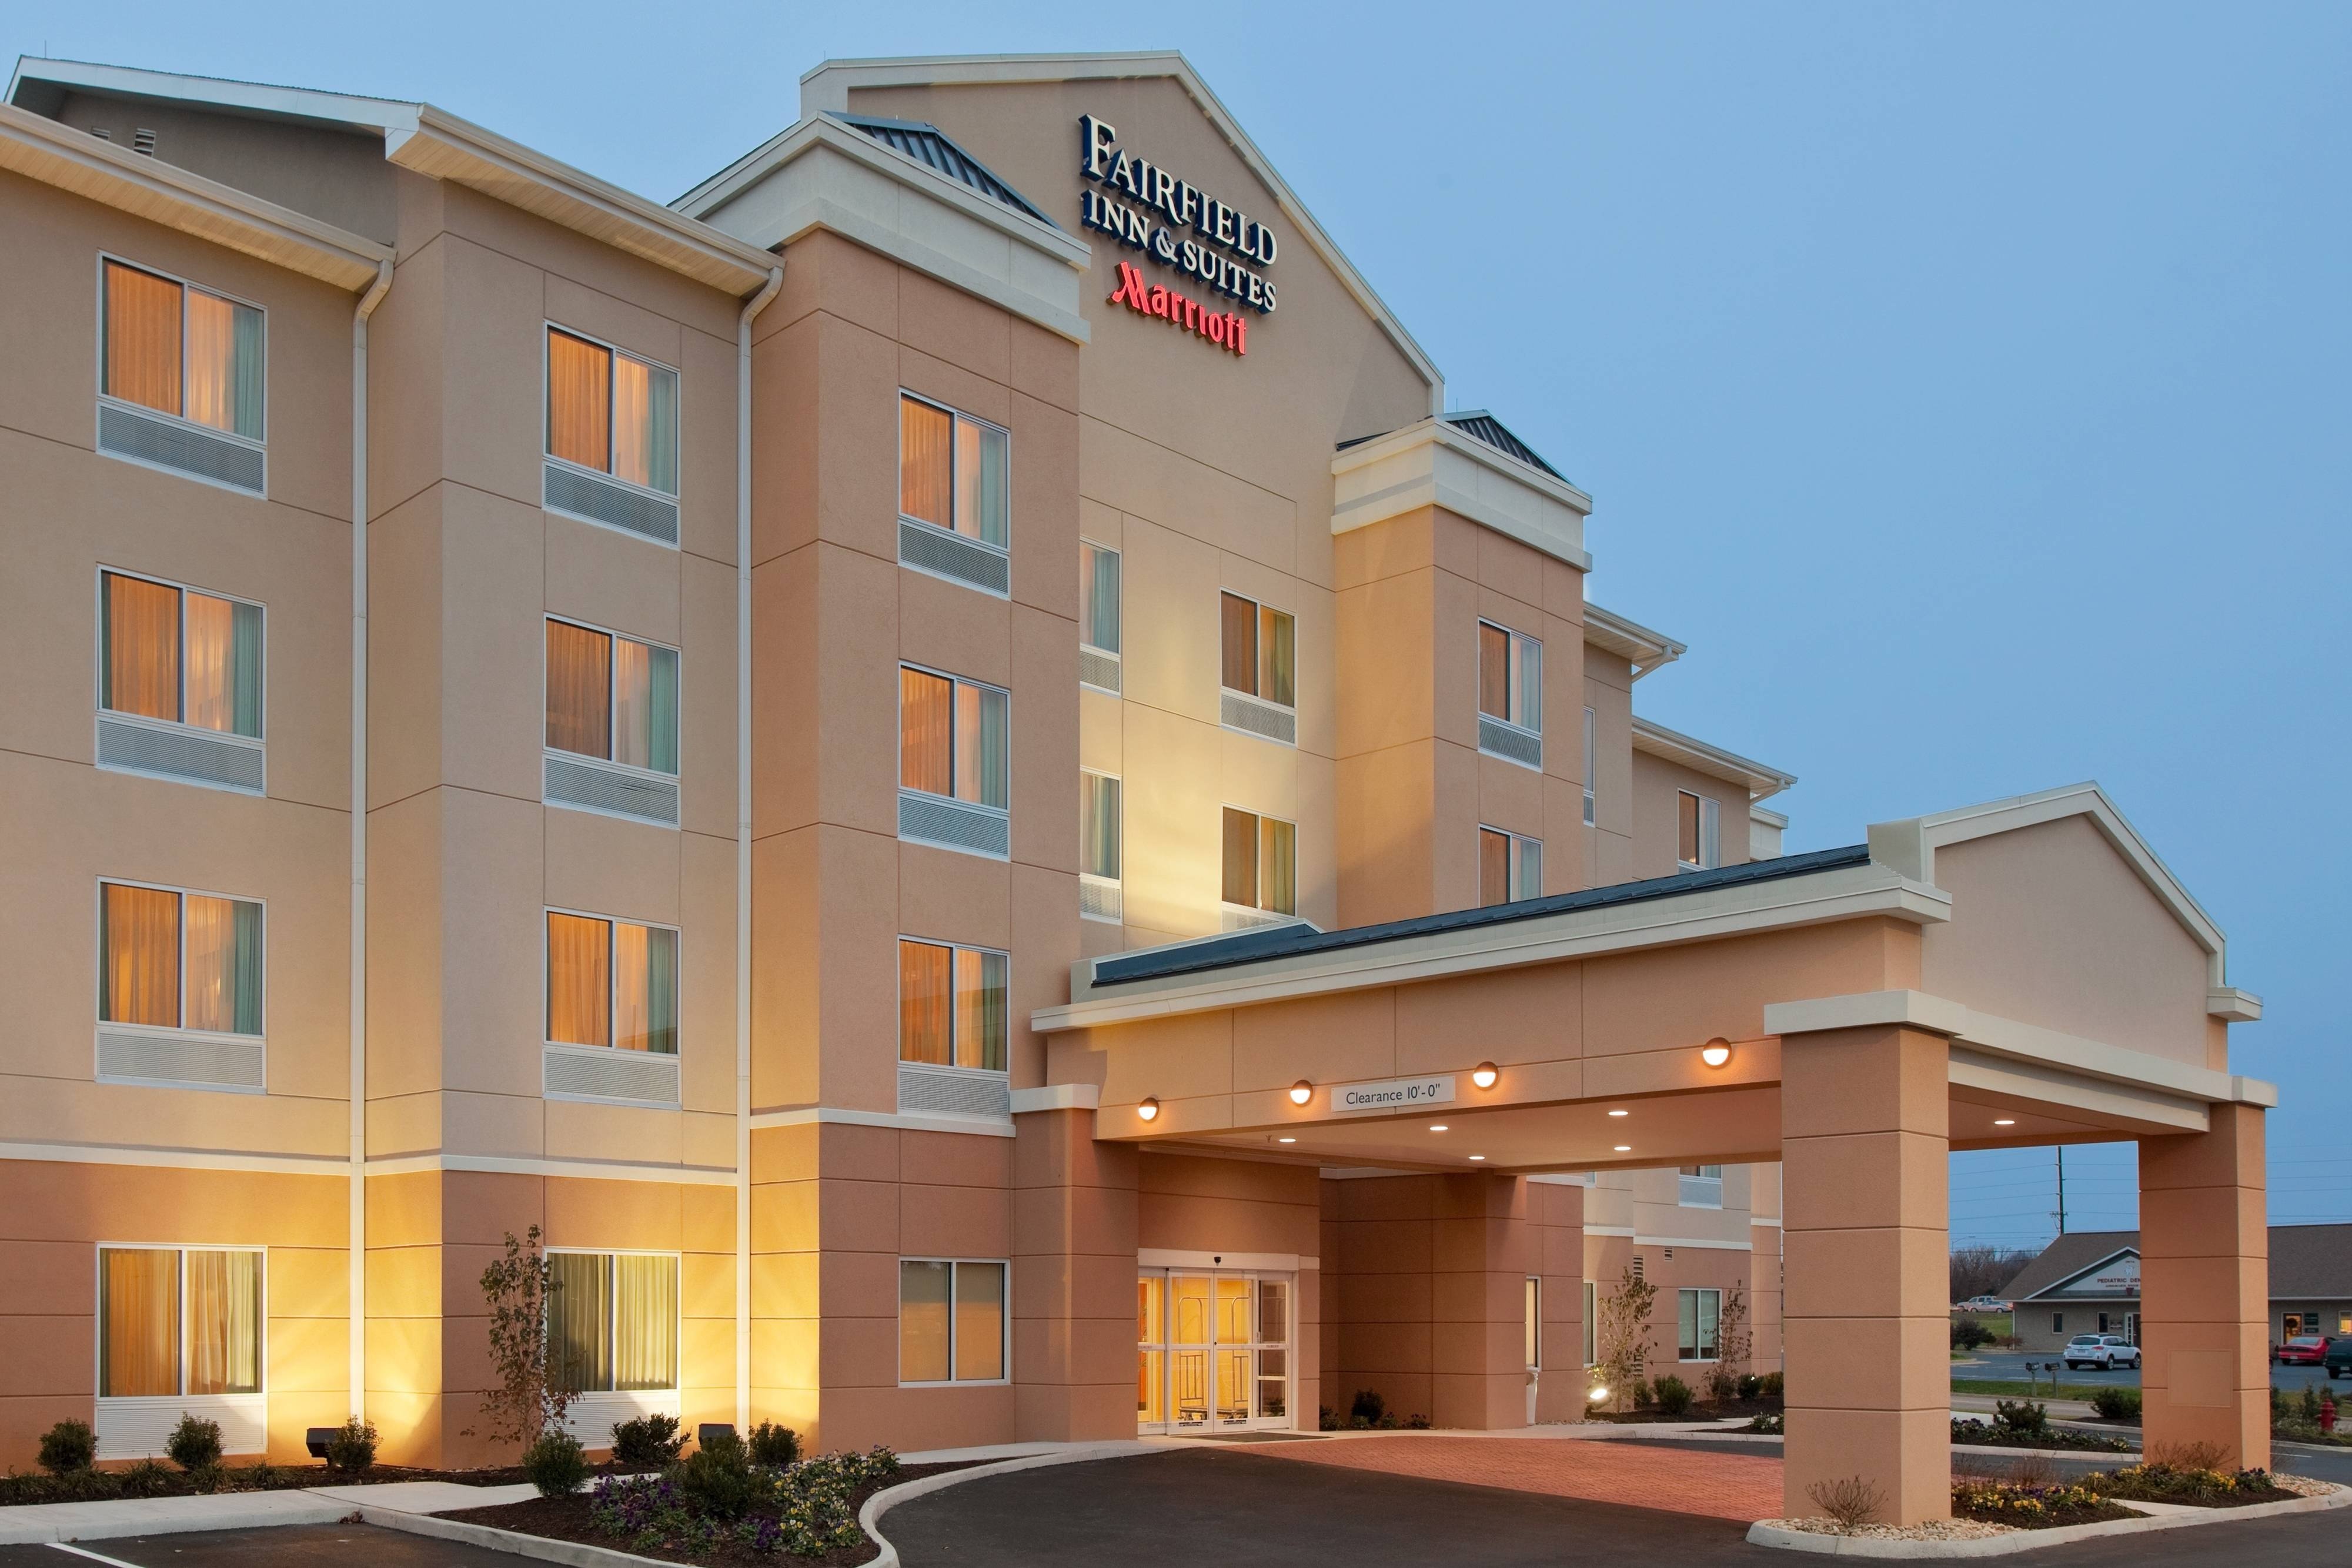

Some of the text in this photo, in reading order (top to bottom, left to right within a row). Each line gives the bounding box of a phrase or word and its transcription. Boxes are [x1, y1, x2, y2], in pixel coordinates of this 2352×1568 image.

[1079, 113, 1278, 268] FAIRFIELD
[1081, 189, 1277, 315] INN & SUITES
[1107, 260, 1247, 356] Marriott
[1346, 1091, 1402, 1105] Clearance
